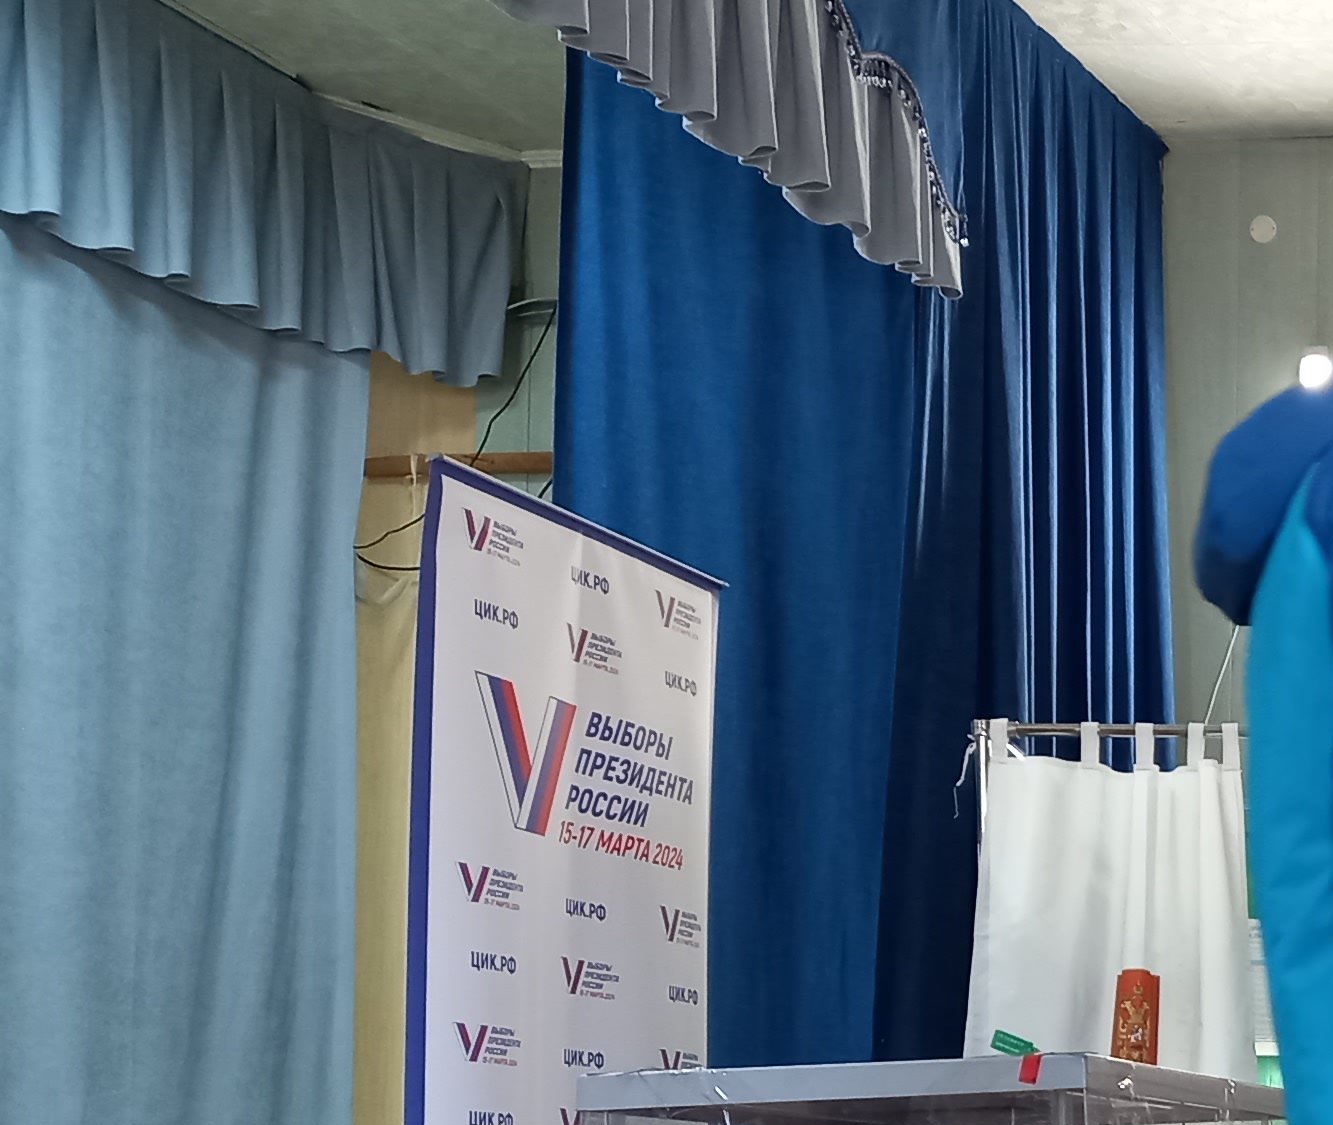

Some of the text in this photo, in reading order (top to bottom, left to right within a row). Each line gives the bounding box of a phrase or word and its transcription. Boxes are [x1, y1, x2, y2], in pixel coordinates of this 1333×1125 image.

[474, 599, 519, 629] ЦИК.РФ
[585, 711, 674, 760] ВЫБОРЫ
[574, 748, 694, 805] ПРЕЗИДЕНТА
[565, 784, 649, 827] РОССИИ
[558, 820, 684, 870] 15-17 МАРТА 2024
[565, 897, 607, 921] ЦИК.РФ
[471, 951, 517, 975] ЦИК.РФ
[668, 985, 699, 1006] ЦИК.РФ
[563, 1048, 605, 1069] ЦИК.РФ
